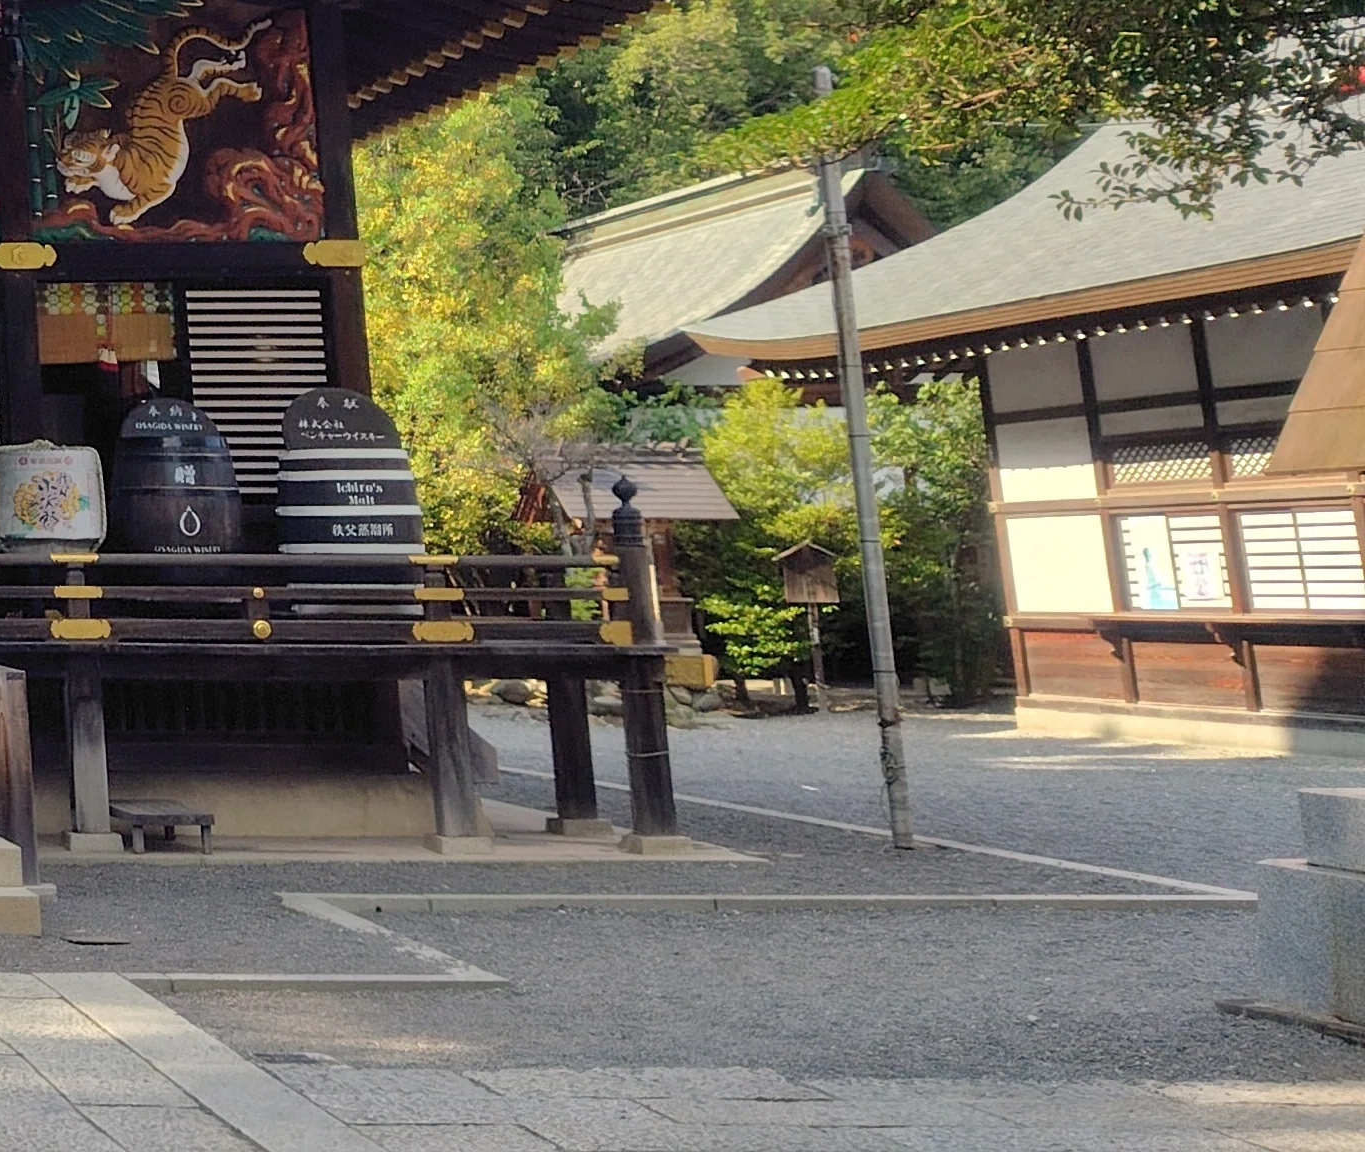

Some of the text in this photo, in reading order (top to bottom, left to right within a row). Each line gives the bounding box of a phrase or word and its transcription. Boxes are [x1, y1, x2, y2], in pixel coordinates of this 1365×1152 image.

[298, 419, 345, 429] 株式会社
[174, 464, 195, 485] 贈
[336, 482, 383, 493] Ichiro's
[349, 495, 374, 505] Malt
